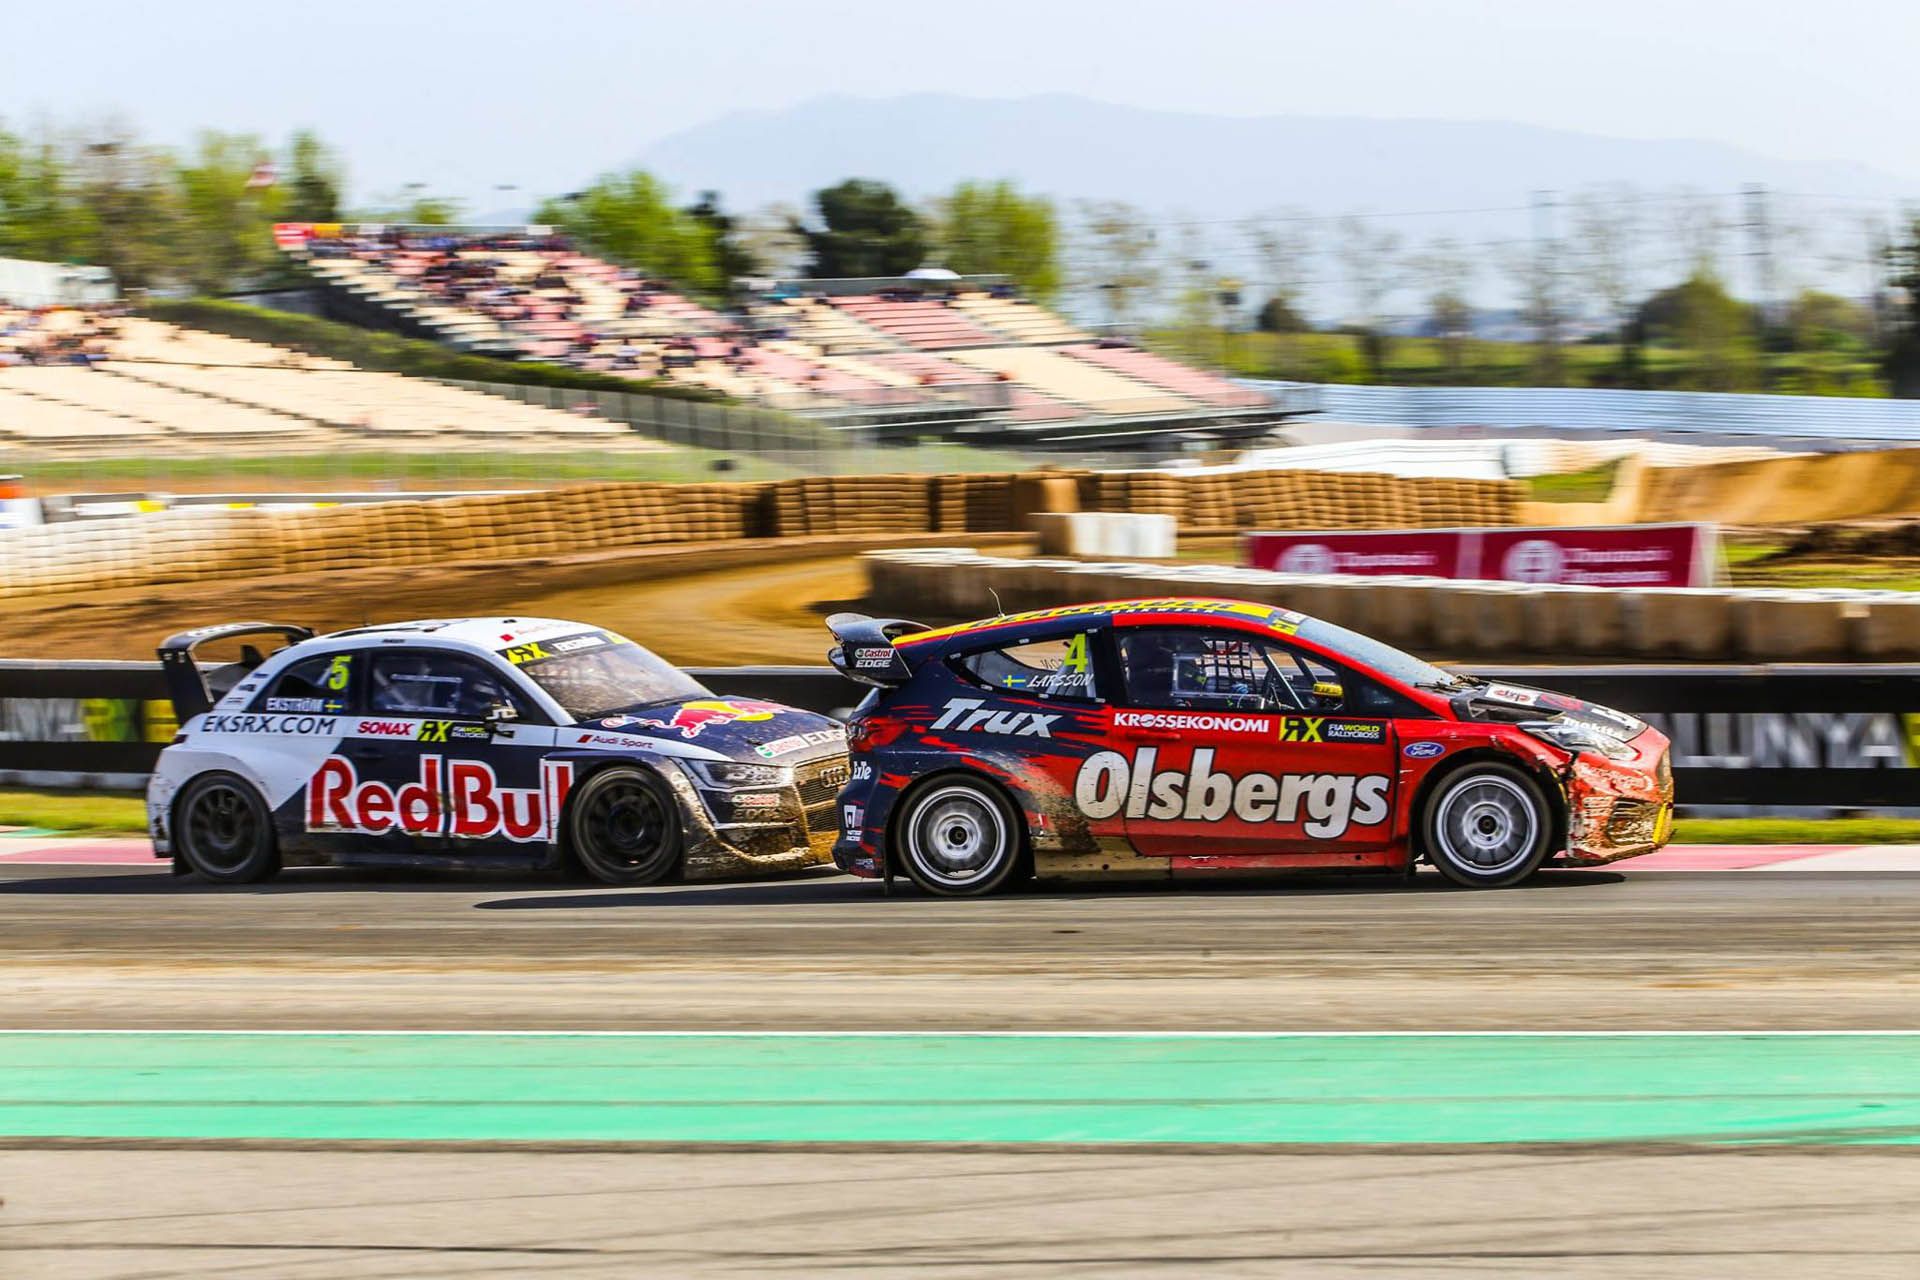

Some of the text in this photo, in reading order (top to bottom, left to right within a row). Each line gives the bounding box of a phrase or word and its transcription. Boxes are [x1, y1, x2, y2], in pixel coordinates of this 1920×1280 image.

[865, 650, 891, 658] Castrol
[1064, 633, 1088, 672] 4
[856, 660, 892, 668] EDGE
[328, 655, 351, 690] 5
[1026, 673, 1094, 688] LARSSON
[201, 715, 337, 735] EKSRX.COM
[931, 698, 1063, 738] Trux
[357, 721, 415, 735] SONAX
[1327, 731, 1380, 739] RALLYCROSS
[591, 735, 654, 750] Audi Sport
[1410, 744, 1438, 757] Ford
[306, 755, 441, 837] Red
[1075, 746, 1392, 841] Olsbergs
